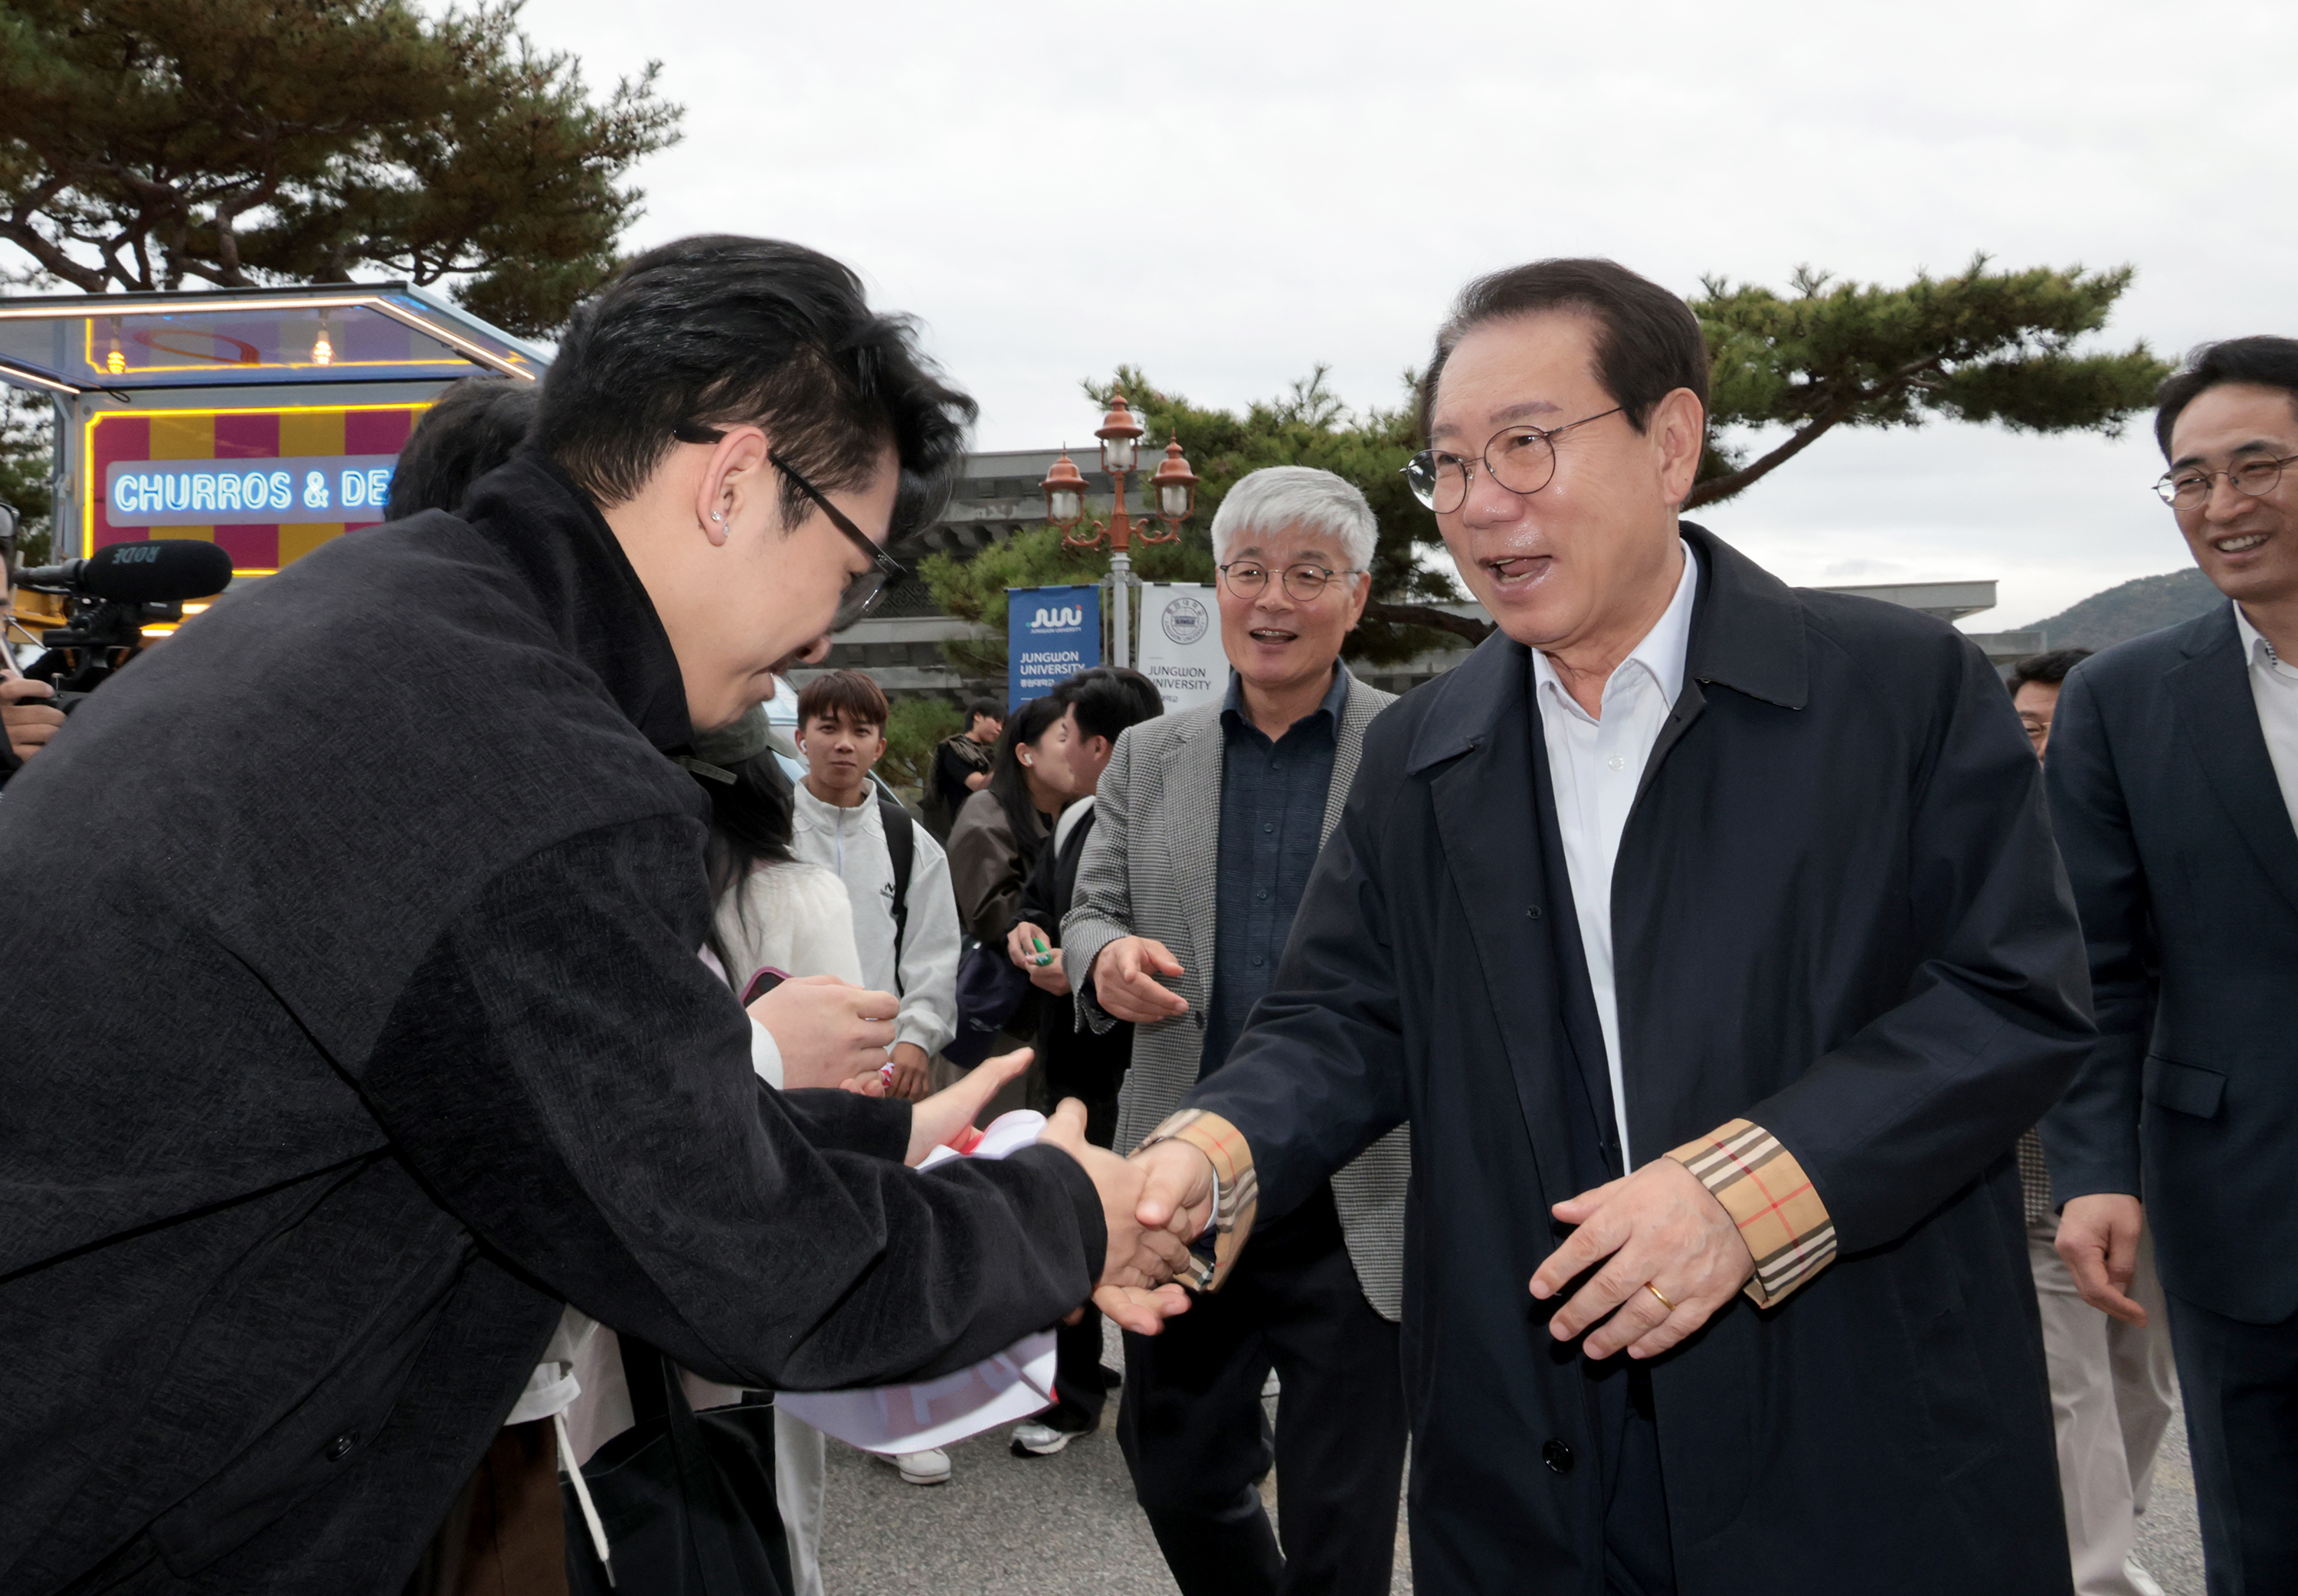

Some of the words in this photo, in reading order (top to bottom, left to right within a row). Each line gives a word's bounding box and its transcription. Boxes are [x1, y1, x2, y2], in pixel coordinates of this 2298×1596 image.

[114, 471, 293, 512] CHURROS
[303, 471, 329, 509] &
[341, 469, 390, 506] DE
[1020, 651, 1079, 664] JUNGWON
[1020, 663, 1085, 675] UNIVERSITY
[1148, 666, 1206, 678] JUNGWON
